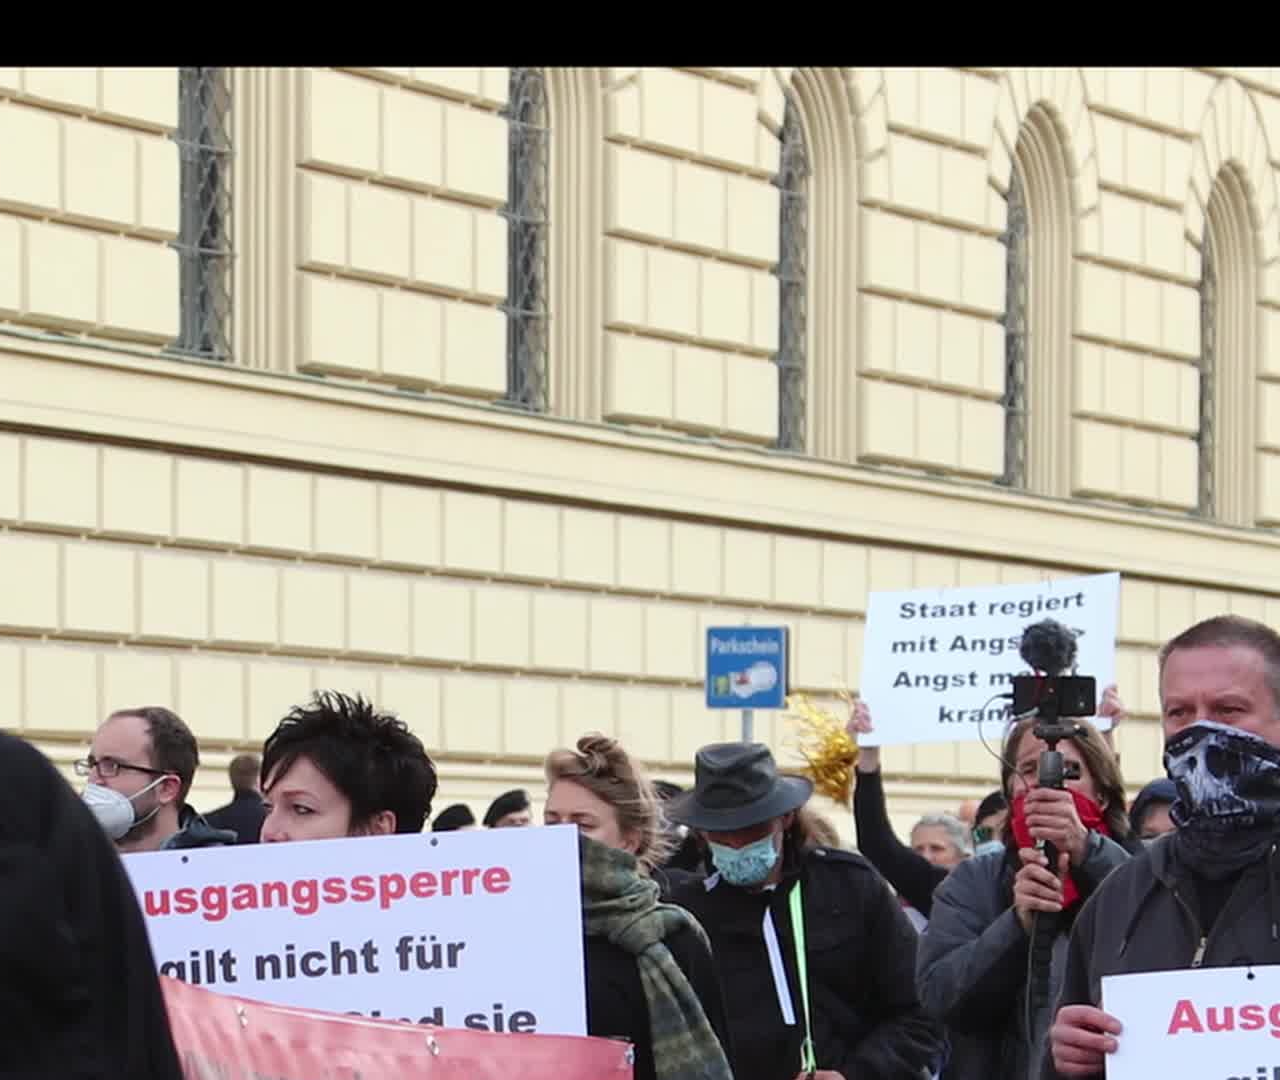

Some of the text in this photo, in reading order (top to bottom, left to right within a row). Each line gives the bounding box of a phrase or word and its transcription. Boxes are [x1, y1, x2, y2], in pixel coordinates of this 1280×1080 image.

[899, 591, 1085, 619] Staat regiert
[891, 635, 1022, 658] mit Angs
[892, 671, 979, 692] Angst
[144, 866, 512, 922] usgangssperre
[255, 940, 379, 981] nicht
[395, 935, 466, 972] für
